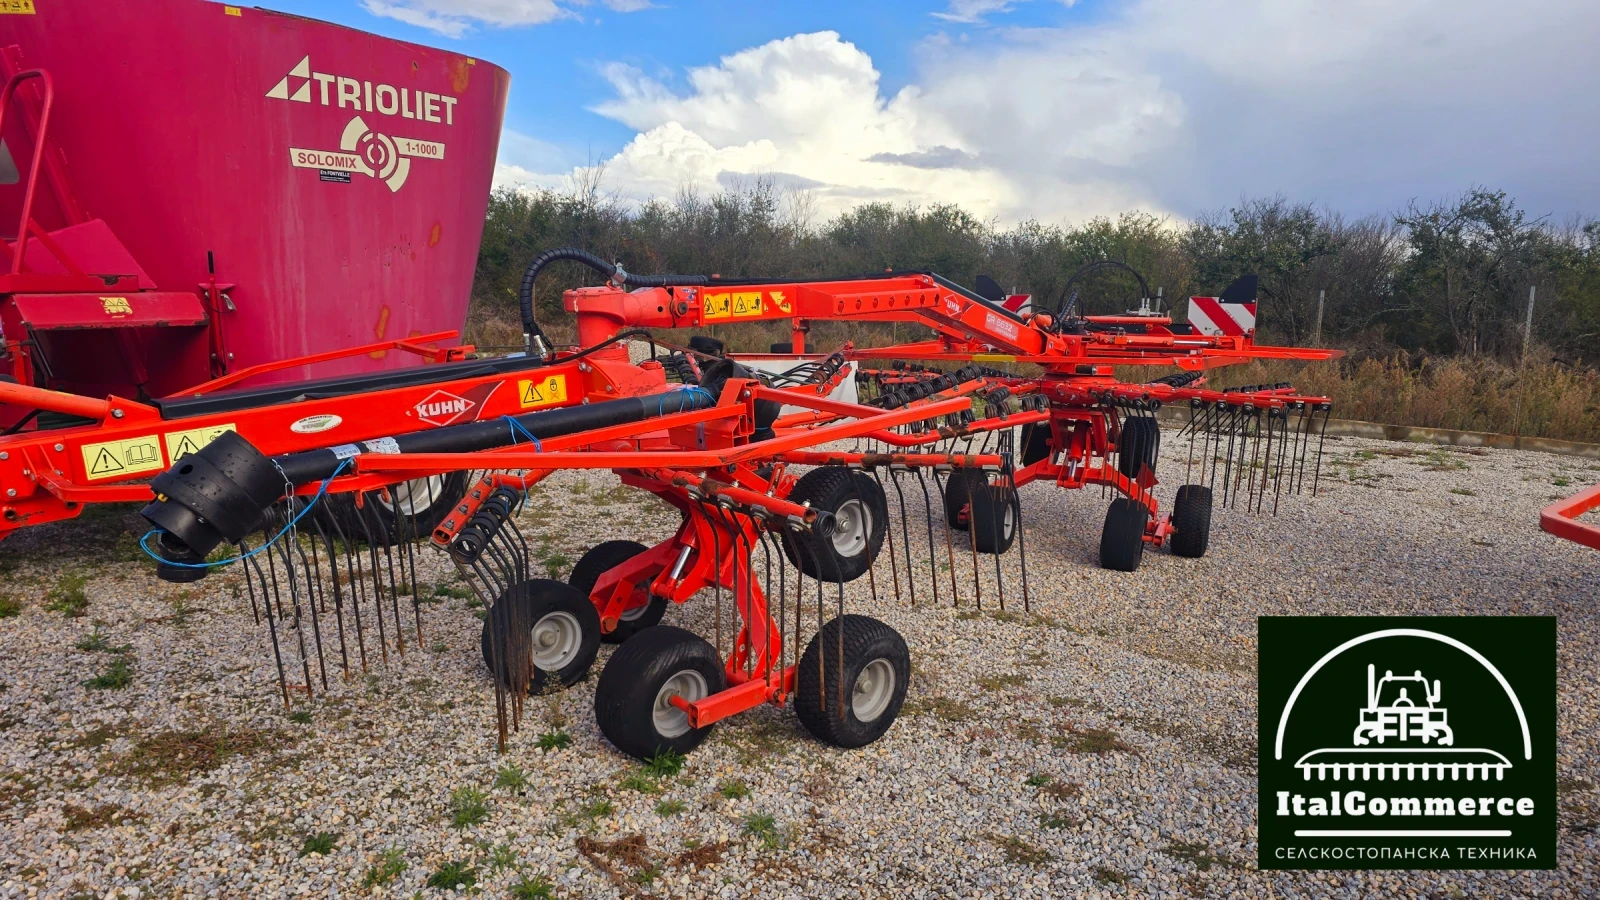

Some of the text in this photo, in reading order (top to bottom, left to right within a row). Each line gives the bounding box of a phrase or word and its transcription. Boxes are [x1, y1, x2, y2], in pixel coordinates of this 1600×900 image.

[312, 71, 458, 125] TRIOLIET
[405, 141, 437, 156] 1-1000
[297, 152, 357, 169] SOLOMIX
[996, 318, 1013, 332] 6632
[416, 399, 466, 418] KUHN
